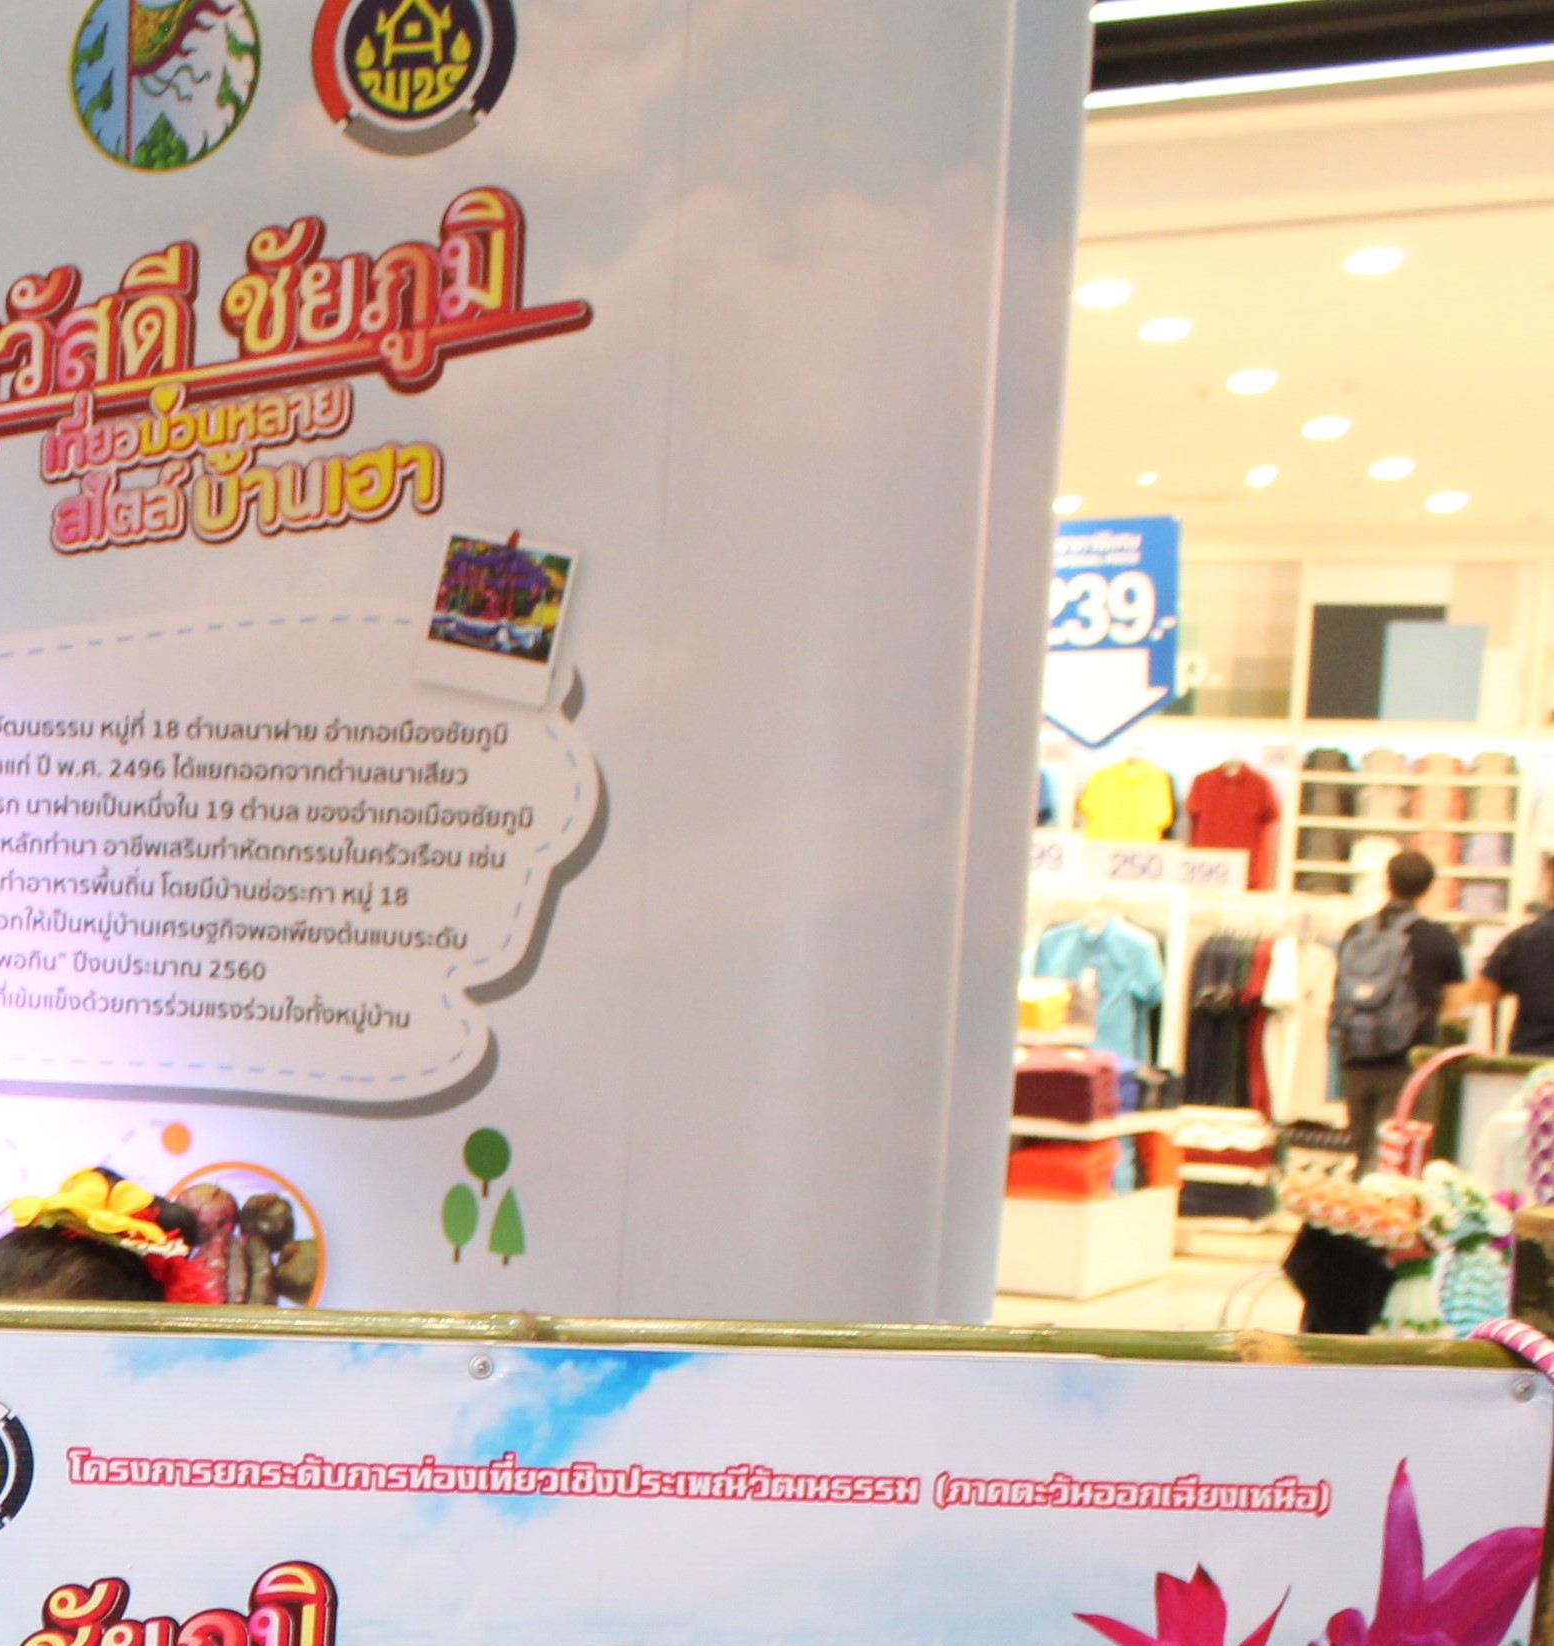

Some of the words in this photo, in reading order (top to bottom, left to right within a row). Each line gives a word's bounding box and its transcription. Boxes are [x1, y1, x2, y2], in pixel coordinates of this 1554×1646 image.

[219, 186, 523, 394] ชัยภูมิ
[51, 458, 188, 555] สไตล์
[190, 440, 444, 546] บ้านเฮา
[101, 709, 145, 747] หมู่ที่
[152, 719, 180, 740] 18
[187, 717, 318, 743] ตำบลนาฝาย
[36, 752, 52, 777] ปี
[109, 757, 166, 779] 2496
[206, 799, 234, 820] 19
[240, 797, 299, 822] ตำบล
[468, 840, 506, 869] เช่น
[379, 886, 409, 907] 18
[73, 950, 202, 978] ปีงบประมาณ
[208, 958, 267, 982] 2560
[66, 1446, 921, 1506] โครงการยกระดับการท่องเที่ยวเชิงประเพณีวัฒนธรรม
[932, 1467, 1332, 1518] (ภาคตะวันออกเฉียงเหนือ)
